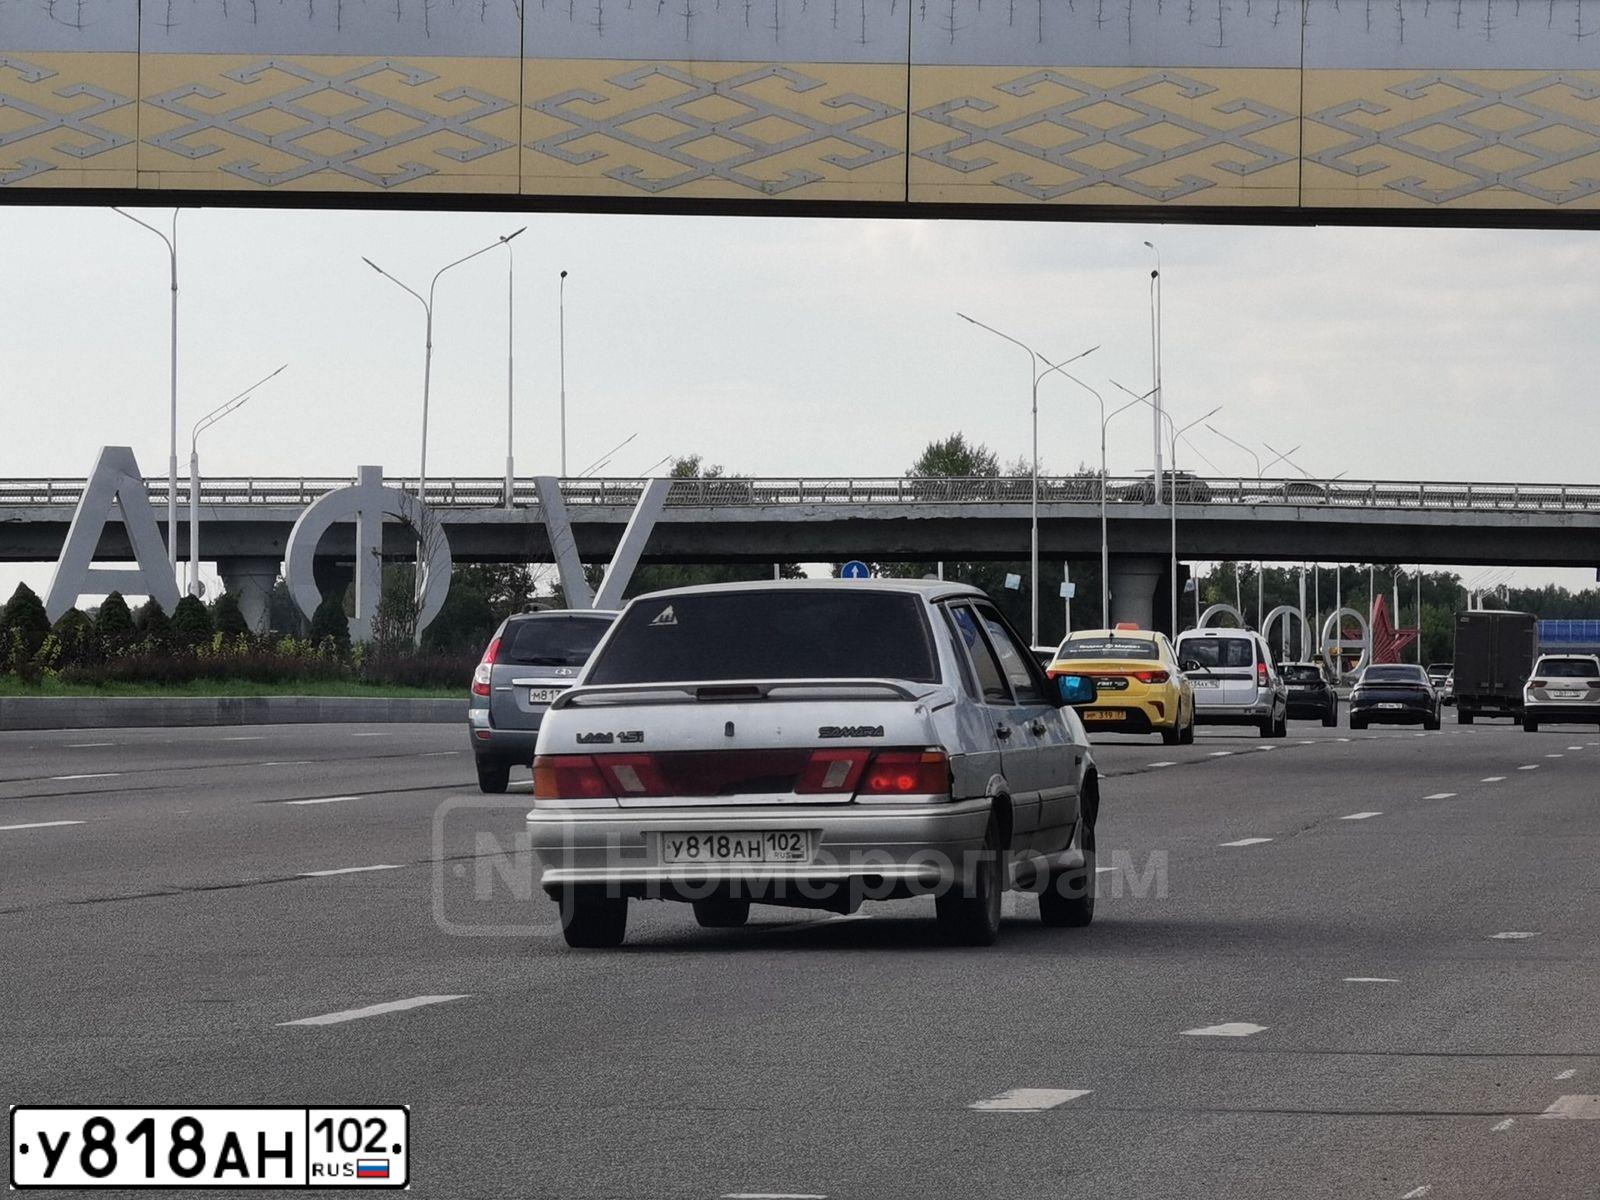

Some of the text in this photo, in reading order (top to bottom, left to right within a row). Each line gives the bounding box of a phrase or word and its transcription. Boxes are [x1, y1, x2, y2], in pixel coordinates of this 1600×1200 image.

[818, 725, 884, 738] SAMARA
[671, 833, 801, 858] У818АН 102
[774, 851, 792, 859] RUS
